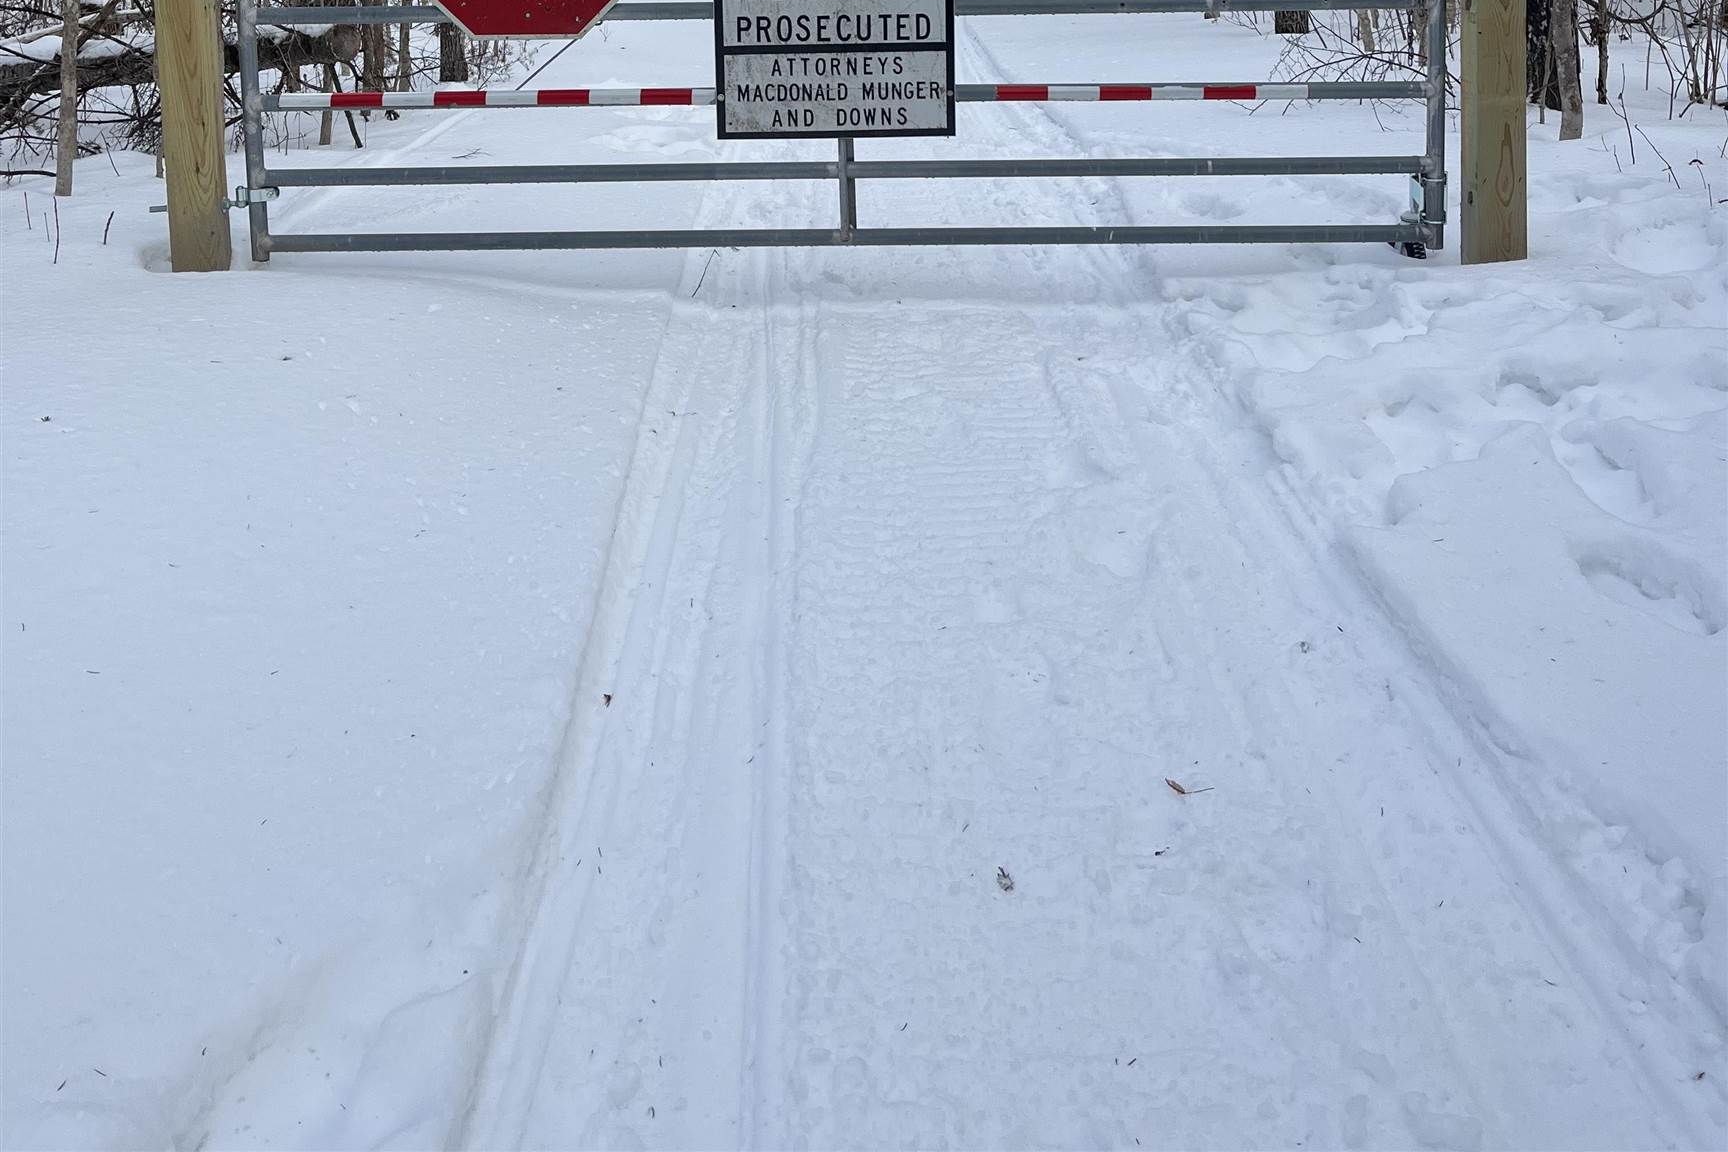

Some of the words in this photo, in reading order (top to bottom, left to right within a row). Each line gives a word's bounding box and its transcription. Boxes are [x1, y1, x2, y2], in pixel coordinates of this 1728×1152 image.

[736, 13, 931, 43] PROSECUTED
[771, 56, 904, 77] ATTORNEYS
[737, 83, 848, 102] MACDONALD
[862, 81, 941, 100] MUNGER
[772, 109, 815, 127] AND
[836, 107, 908, 126] DOWNS
